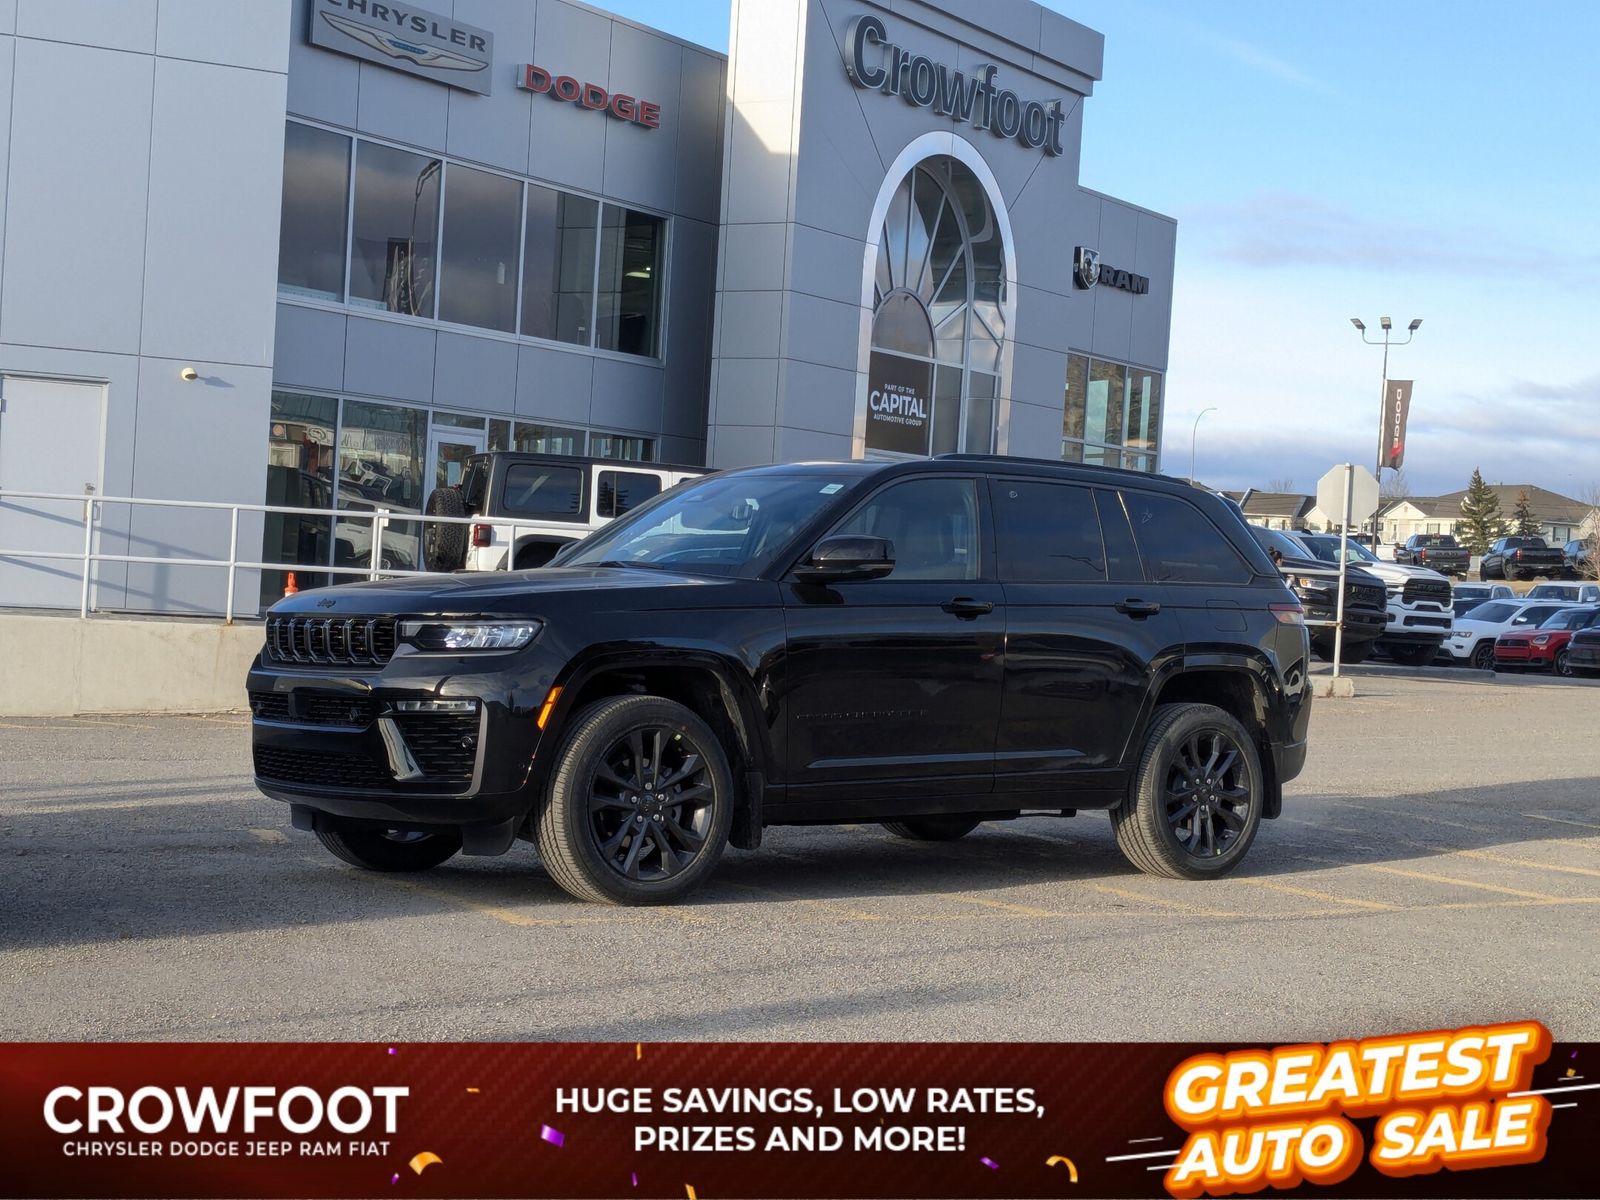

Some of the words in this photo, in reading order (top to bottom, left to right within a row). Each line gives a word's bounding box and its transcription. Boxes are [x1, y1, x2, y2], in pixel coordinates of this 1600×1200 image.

[518, 63, 661, 129] DODGE
[845, 14, 1065, 158] Crowfoot
[1099, 263, 1149, 295] RAM
[870, 390, 927, 419] CAPITAL
[884, 383, 898, 391] PART
[906, 387, 916, 395] THE
[873, 413, 905, 425] AUTOMOTIVE
[905, 418, 923, 427] GROUP
[1392, 388, 1403, 449] DODGE
